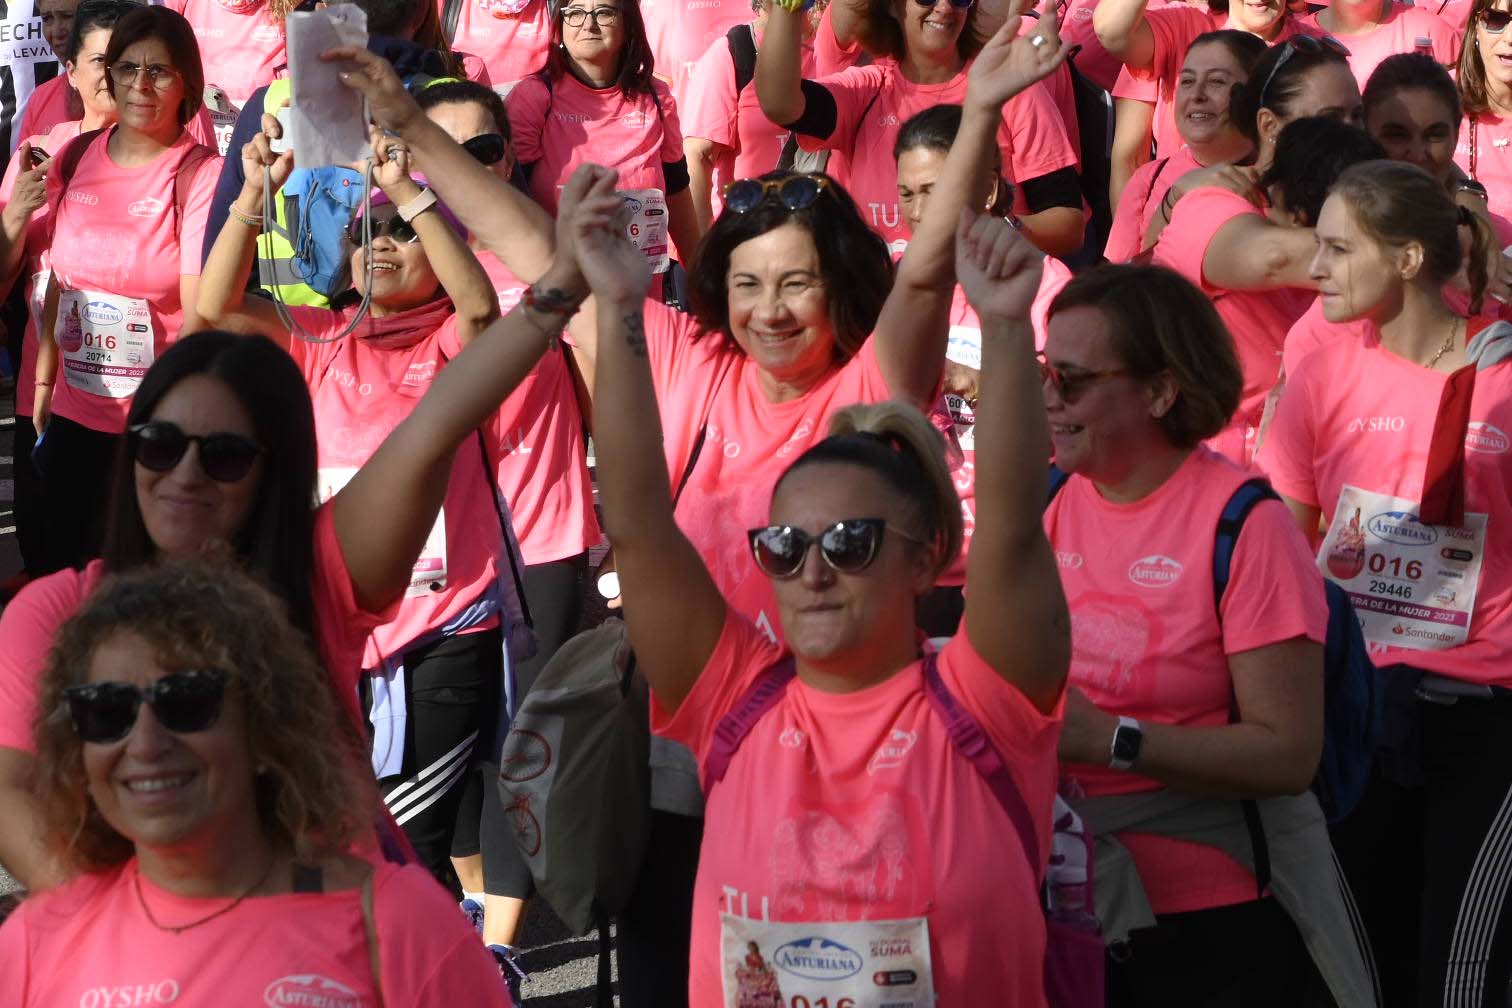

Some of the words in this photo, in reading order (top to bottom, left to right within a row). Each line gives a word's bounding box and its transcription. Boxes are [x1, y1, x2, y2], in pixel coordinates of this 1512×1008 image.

[84, 332, 116, 349] 016
[86, 352, 112, 363] 20714
[1373, 520, 1433, 541] ASTURIANA
[1369, 553, 1423, 580] 016
[1369, 580, 1412, 599] 29446
[1371, 600, 1384, 609] DE
[1385, 603, 1396, 612] LA
[1400, 606, 1430, 618] MUJER
[1405, 626, 1456, 642] Santander
[783, 952, 856, 970] ASTURIANA
[80, 978, 180, 1008] OYSHO
